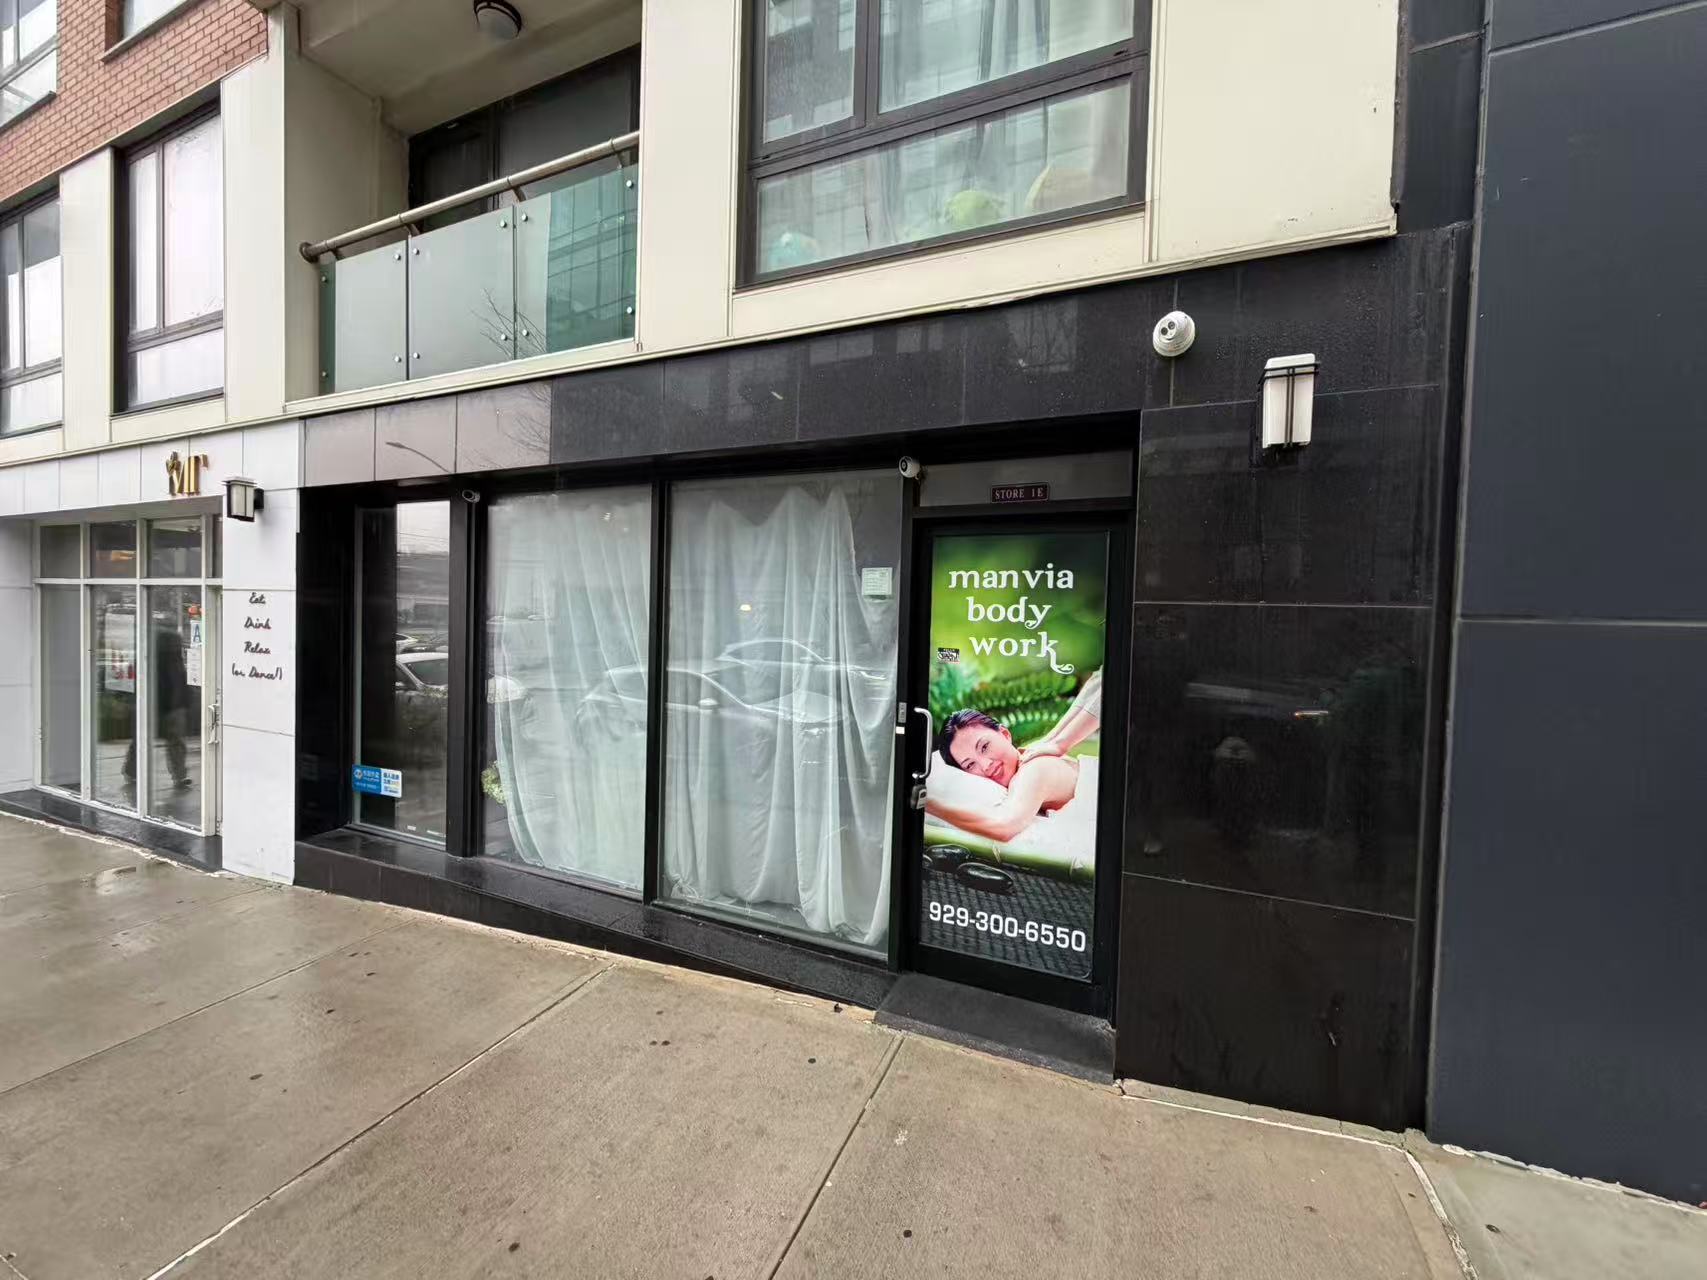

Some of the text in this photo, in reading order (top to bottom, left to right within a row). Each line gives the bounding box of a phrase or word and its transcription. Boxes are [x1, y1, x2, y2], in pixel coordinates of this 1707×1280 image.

[995, 488, 1024, 500] STORE
[248, 592, 266, 604] Eat
[966, 596, 1052, 630] body
[244, 616, 271, 630] Drink
[244, 641, 271, 655] Relax
[969, 631, 1075, 675] work
[929, 901, 1086, 952] 929-300-6550
